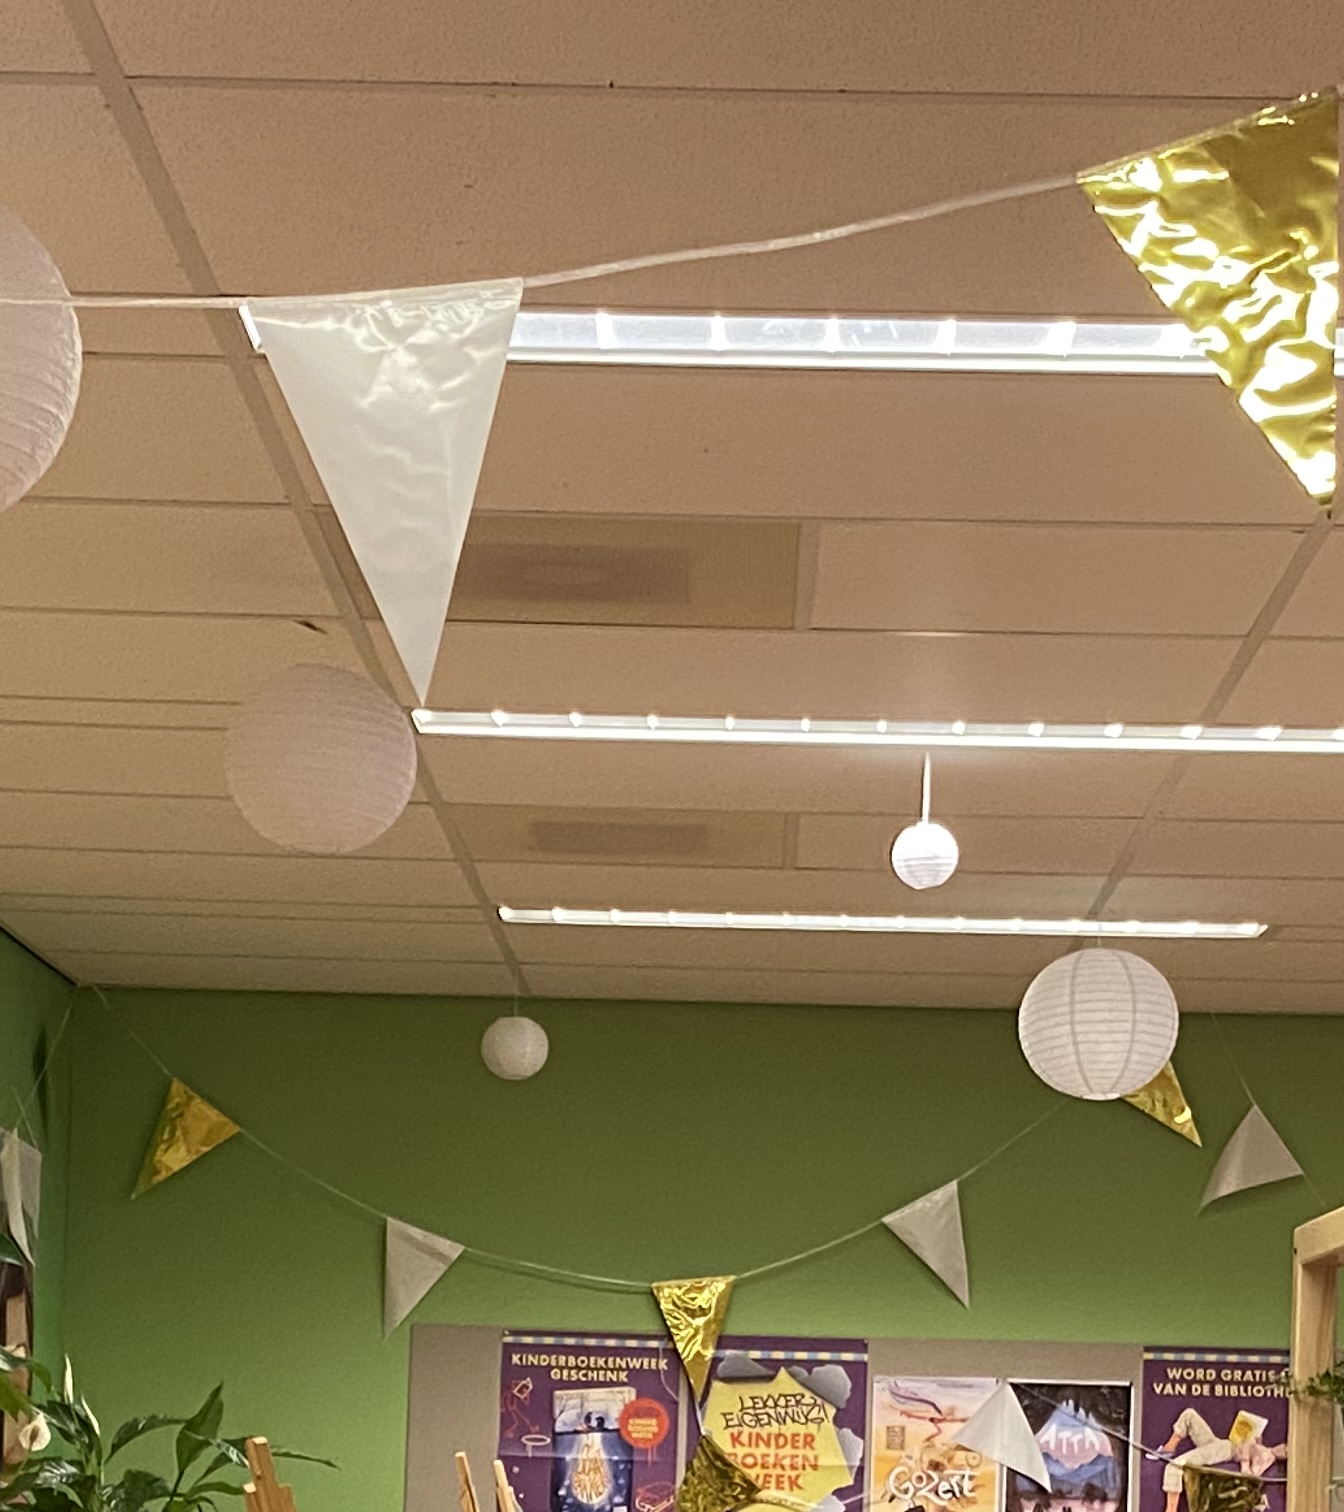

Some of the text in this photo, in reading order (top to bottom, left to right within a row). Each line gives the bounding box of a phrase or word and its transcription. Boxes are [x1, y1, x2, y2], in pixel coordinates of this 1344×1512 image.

[511, 1353, 668, 1370] KINDERBOEKENWEEK
[550, 1368, 629, 1382] GESCHENK
[1166, 1367, 1272, 1383] WORD GRATIS
[1153, 1382, 1186, 1396] VAN
[1191, 1384, 1210, 1397] DE
[730, 1430, 817, 1450] KINDER
[1040, 1426, 1100, 1455] ATTA
[728, 1452, 820, 1472] BOEKEN
